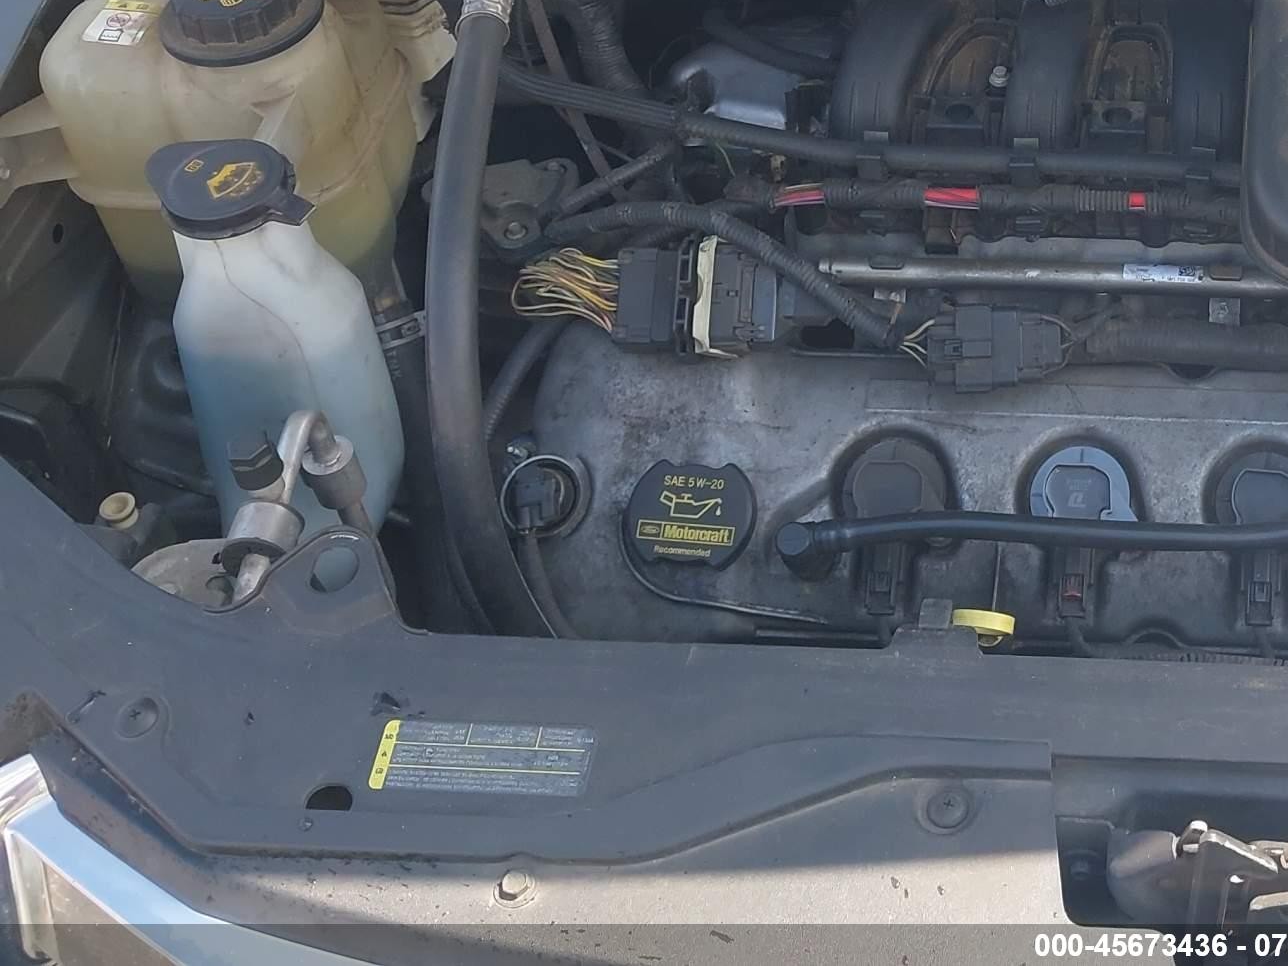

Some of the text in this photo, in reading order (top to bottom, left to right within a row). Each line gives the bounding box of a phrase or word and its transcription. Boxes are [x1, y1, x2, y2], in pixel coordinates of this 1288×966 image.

[664, 475, 725, 490] SAE 5W-20
[663, 525, 730, 543] Motorcraft
[654, 545, 711, 557] Recommended
